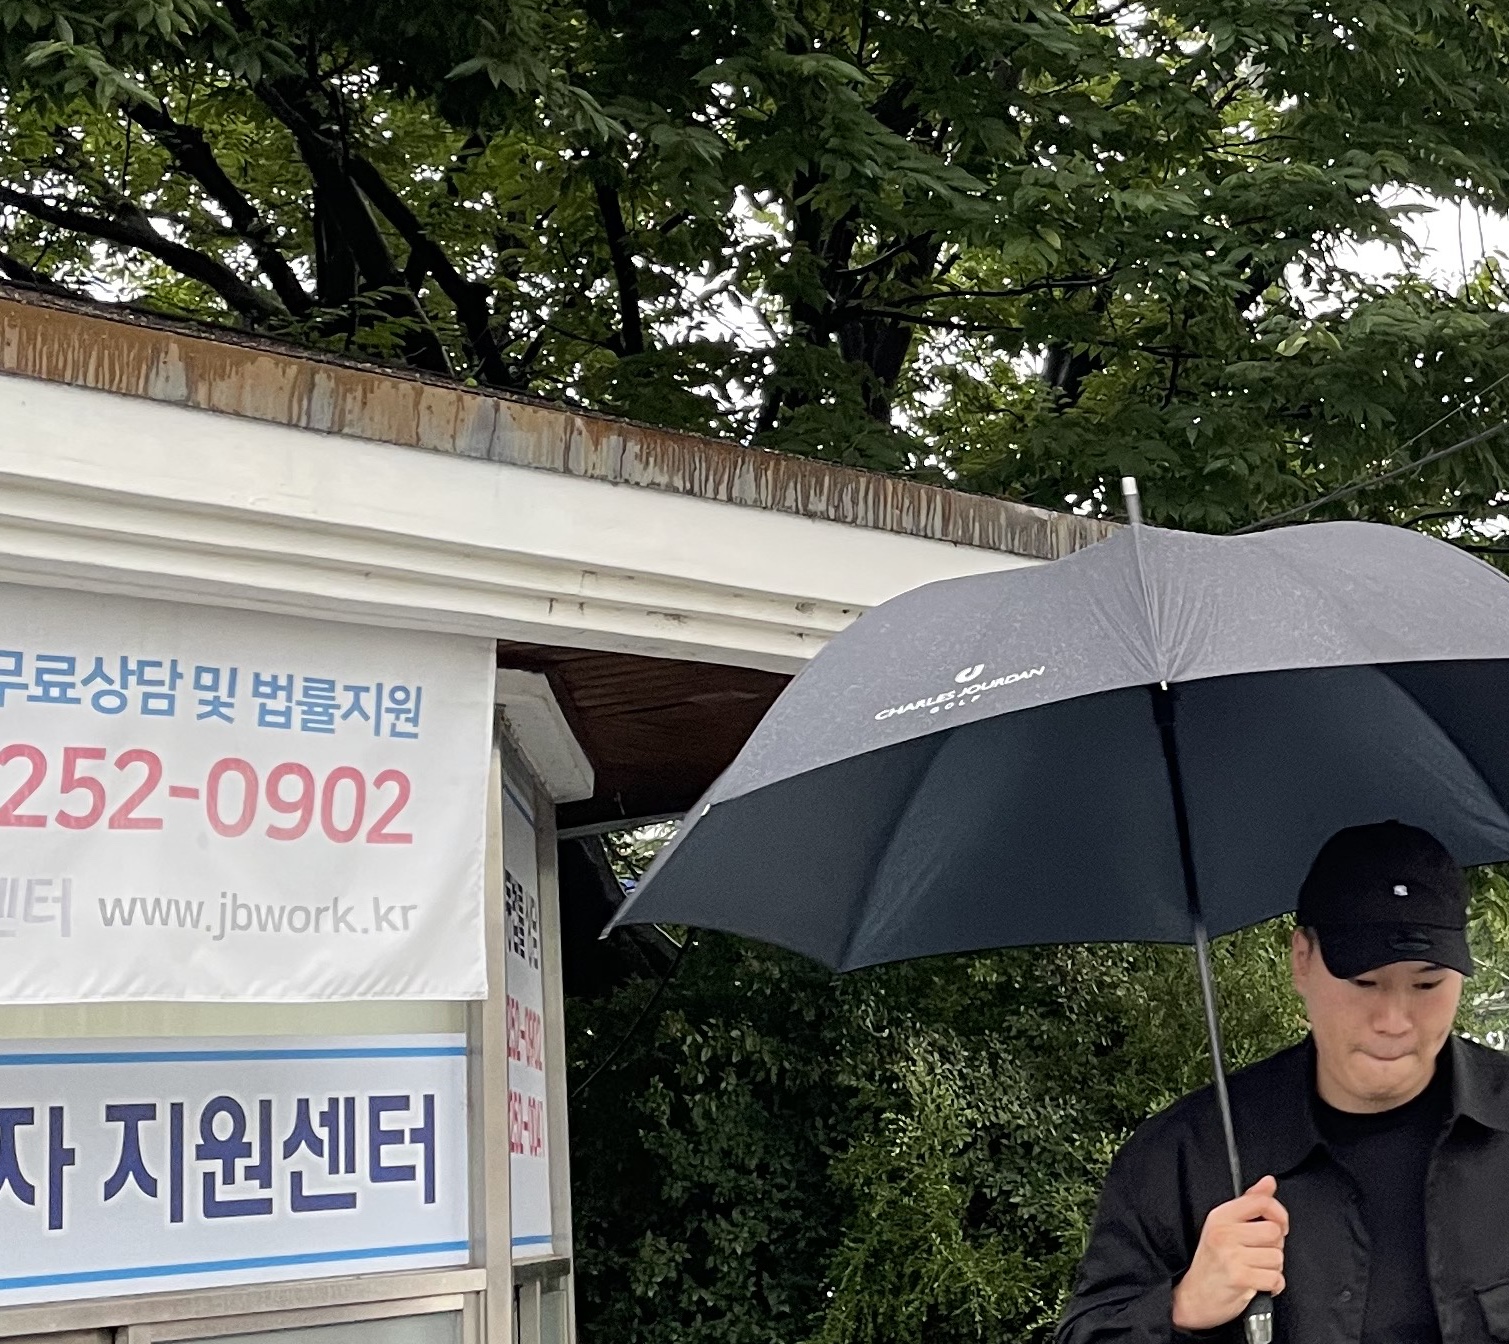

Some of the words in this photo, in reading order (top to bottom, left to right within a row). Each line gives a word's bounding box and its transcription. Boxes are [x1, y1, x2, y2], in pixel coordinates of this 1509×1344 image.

[192, 665, 238, 725] 및
[252, 671, 423, 740] 법률지원
[874, 689, 956, 721] CHARLES
[956, 665, 1046, 699] JOURDAN
[0, 743, 414, 845] 252-0902
[98, 892, 418, 941] www.jbwork.kr
[103, 1094, 436, 1224] 지원센터
